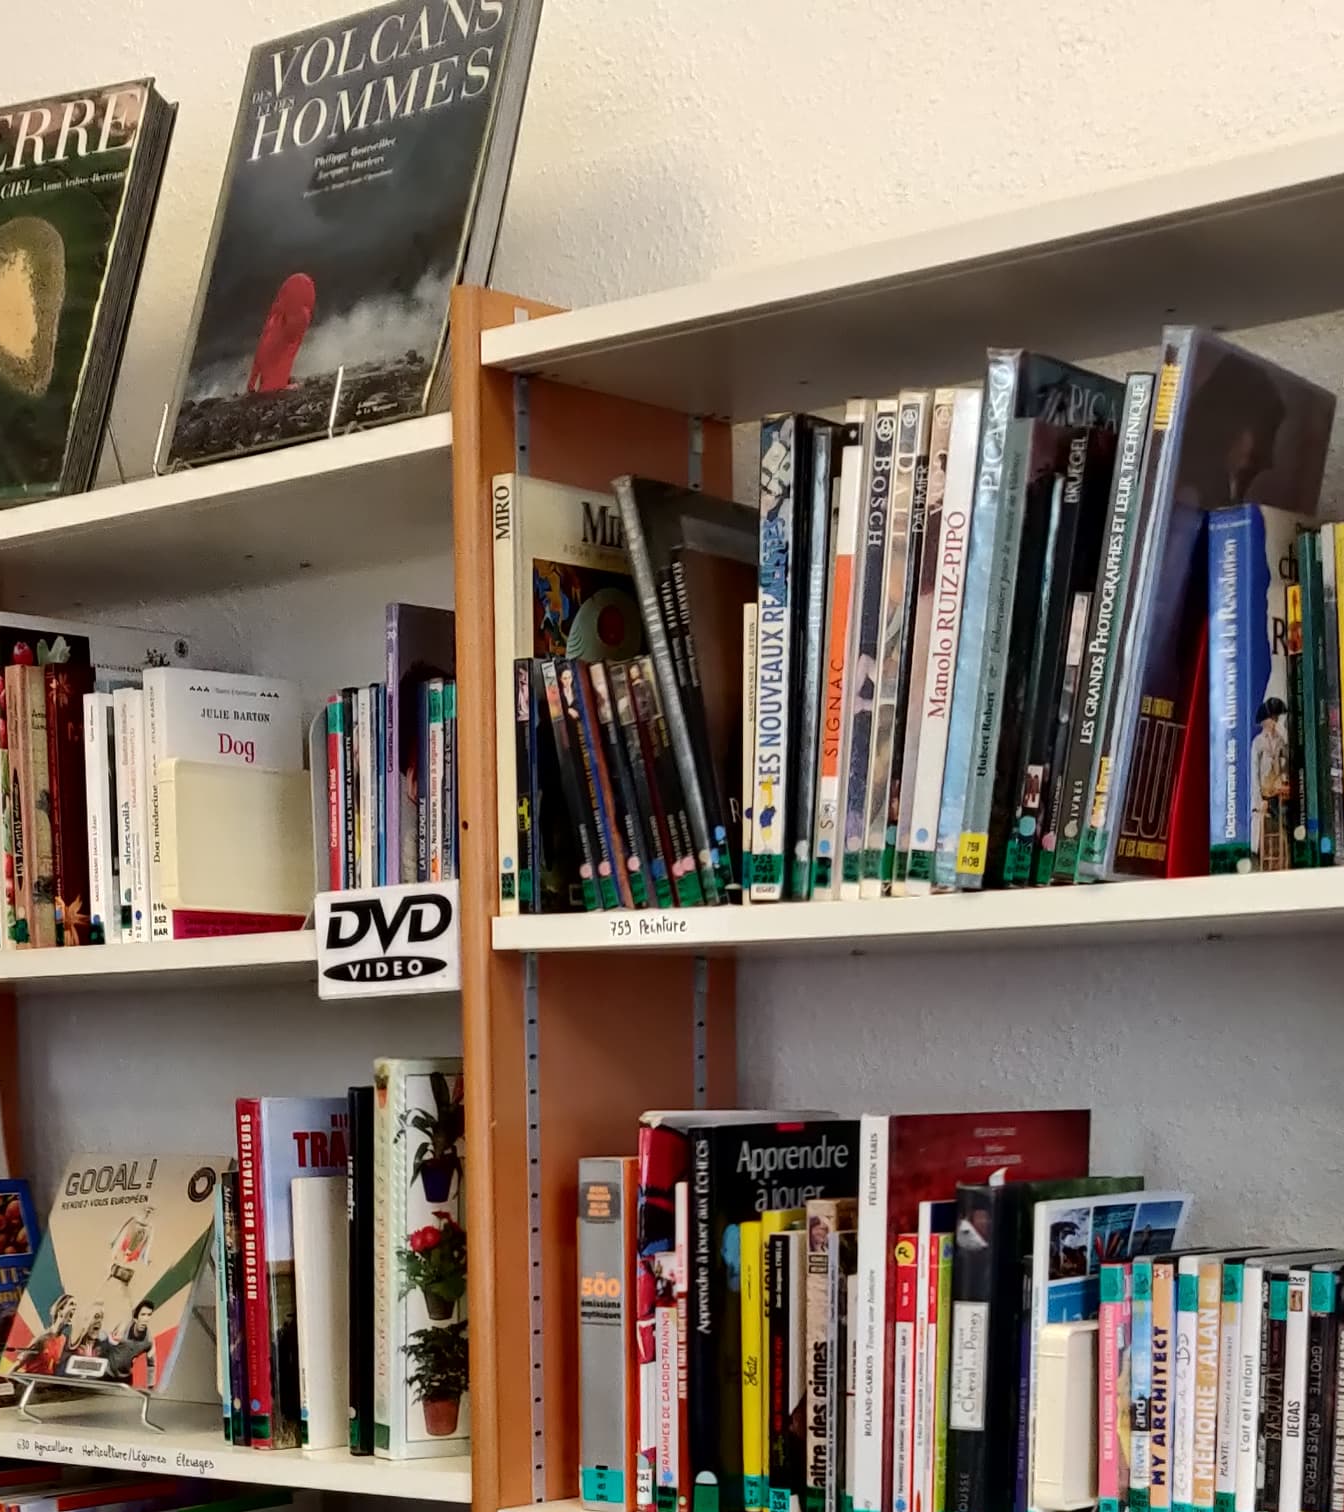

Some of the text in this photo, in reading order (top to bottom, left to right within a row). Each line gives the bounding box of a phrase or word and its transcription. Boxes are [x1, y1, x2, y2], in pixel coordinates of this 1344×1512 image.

[271, 0, 503, 96] VOLCANS
[247, 46, 494, 162] HOMMES
[0, 181, 32, 198] CIEL
[979, 363, 1012, 491] PICASSO
[494, 485, 510, 541] MIRO
[867, 455, 892, 547] BOSCH
[912, 465, 930, 533] DAUMIER
[1081, 381, 1148, 745] LES GRANDS PHOTOGRAPHES ET LEUR TECHNIQUE
[928, 509, 968, 720] Manolo RUIZ-PIPÓ
[200, 708, 271, 723] JULIE BARTON
[758, 635, 787, 787] LES NOUVEAUX
[825, 658, 845, 758] SIGNAC
[218, 733, 255, 762] Dog
[326, 894, 452, 955] DVD
[639, 916, 688, 934] Peinture
[347, 959, 423, 978] VIDEO
[64, 1158, 158, 1197] GOOAL!
[737, 1140, 850, 1176] Apprendre
[240, 1113, 260, 1300] HISTOIRE DES TRACTEURS
[580, 1277, 621, 1298] 500
[813, 1339, 827, 1397] cimes
[1287, 1400, 1300, 1438] DEGAS
